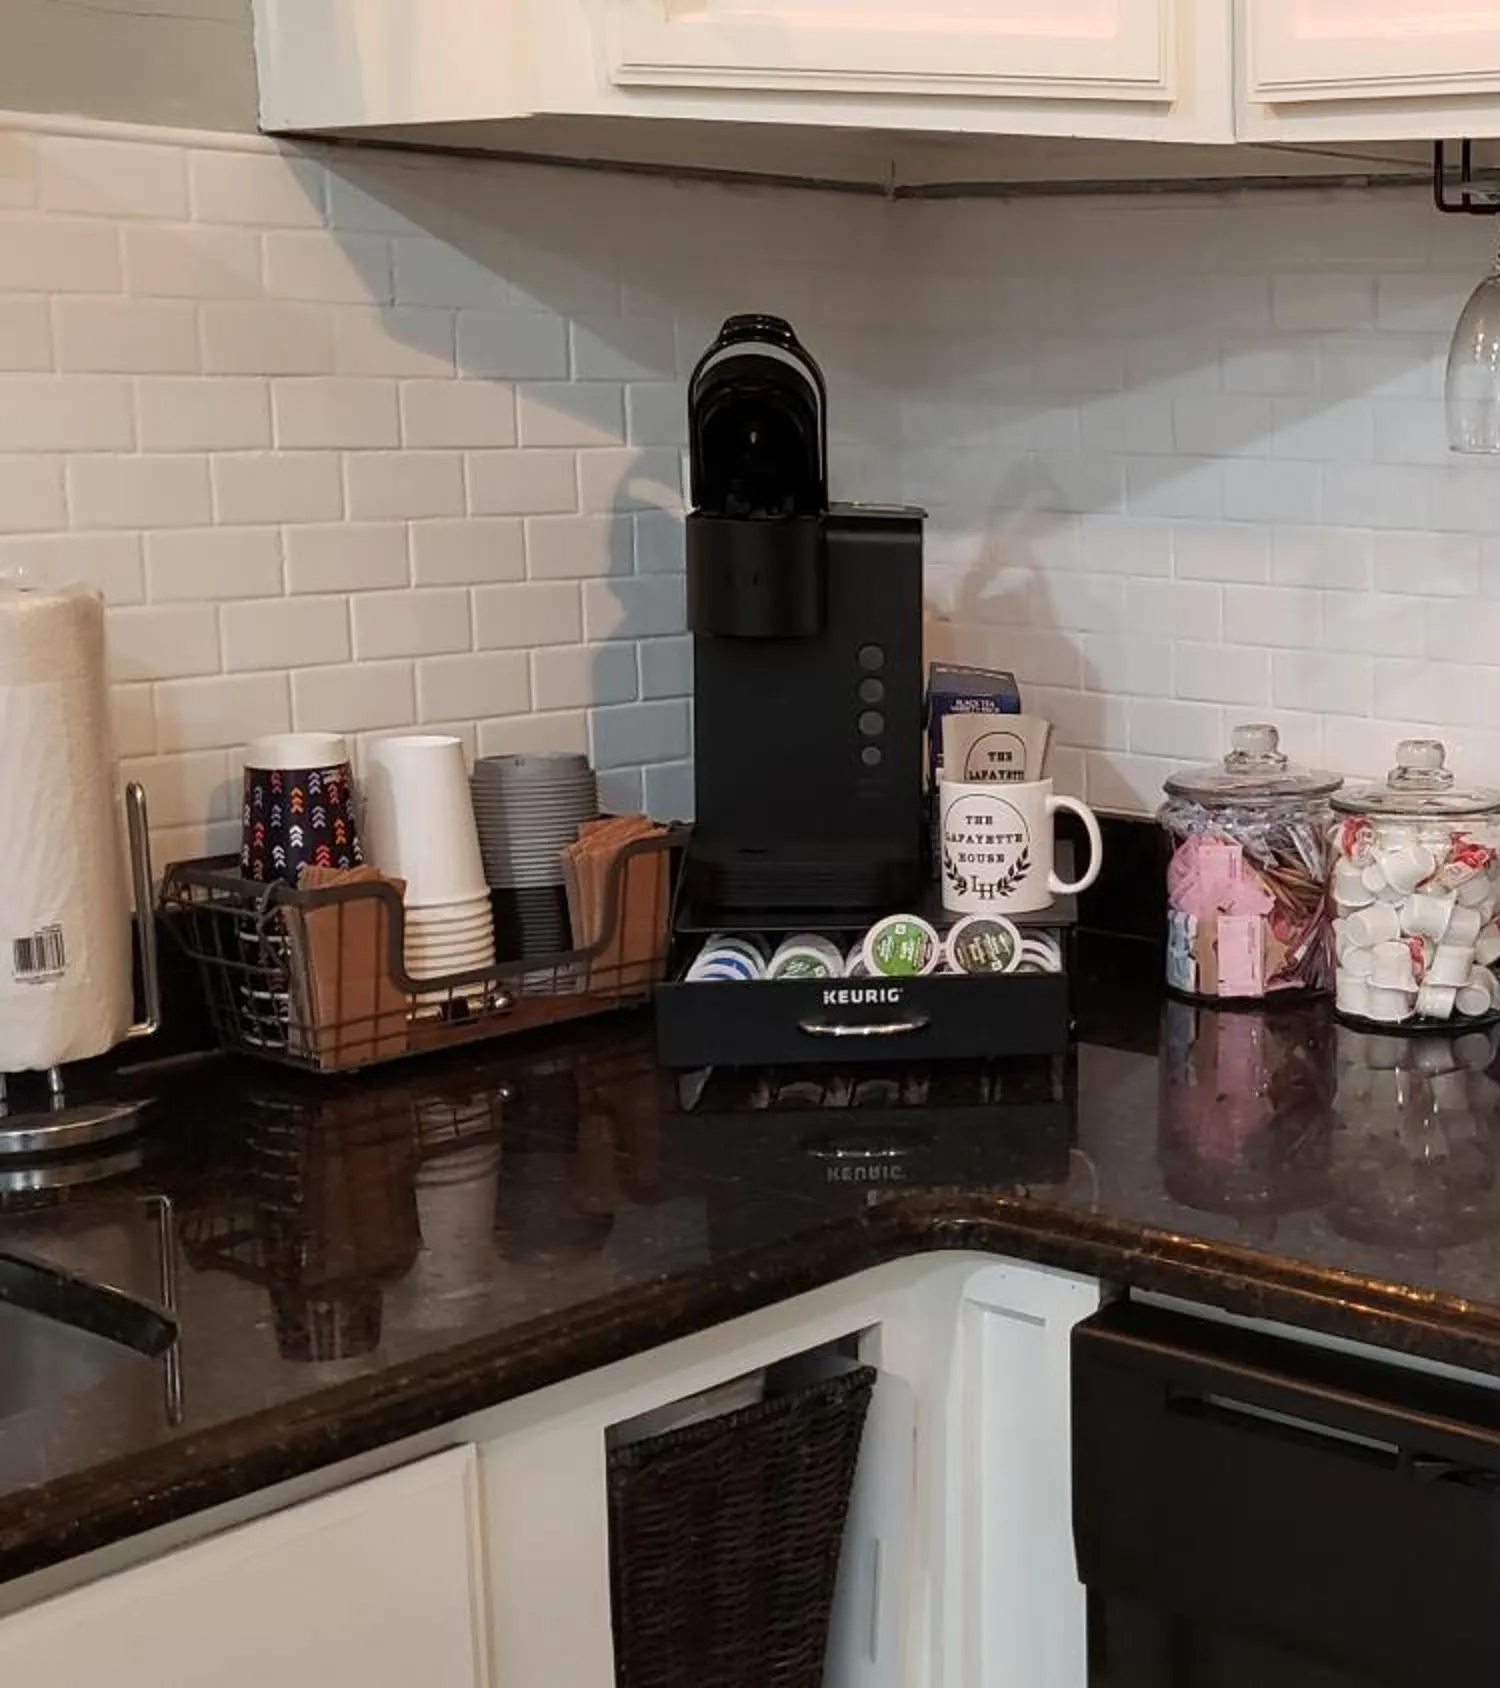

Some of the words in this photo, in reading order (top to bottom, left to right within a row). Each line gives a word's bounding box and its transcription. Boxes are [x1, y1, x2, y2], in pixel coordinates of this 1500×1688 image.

[988, 751, 1012, 762] THE
[965, 815, 993, 825] THE
[945, 831, 1023, 845] LAFAYETTE
[958, 852, 1005, 863] HOUSE
[823, 988, 901, 1006] KEURIG
